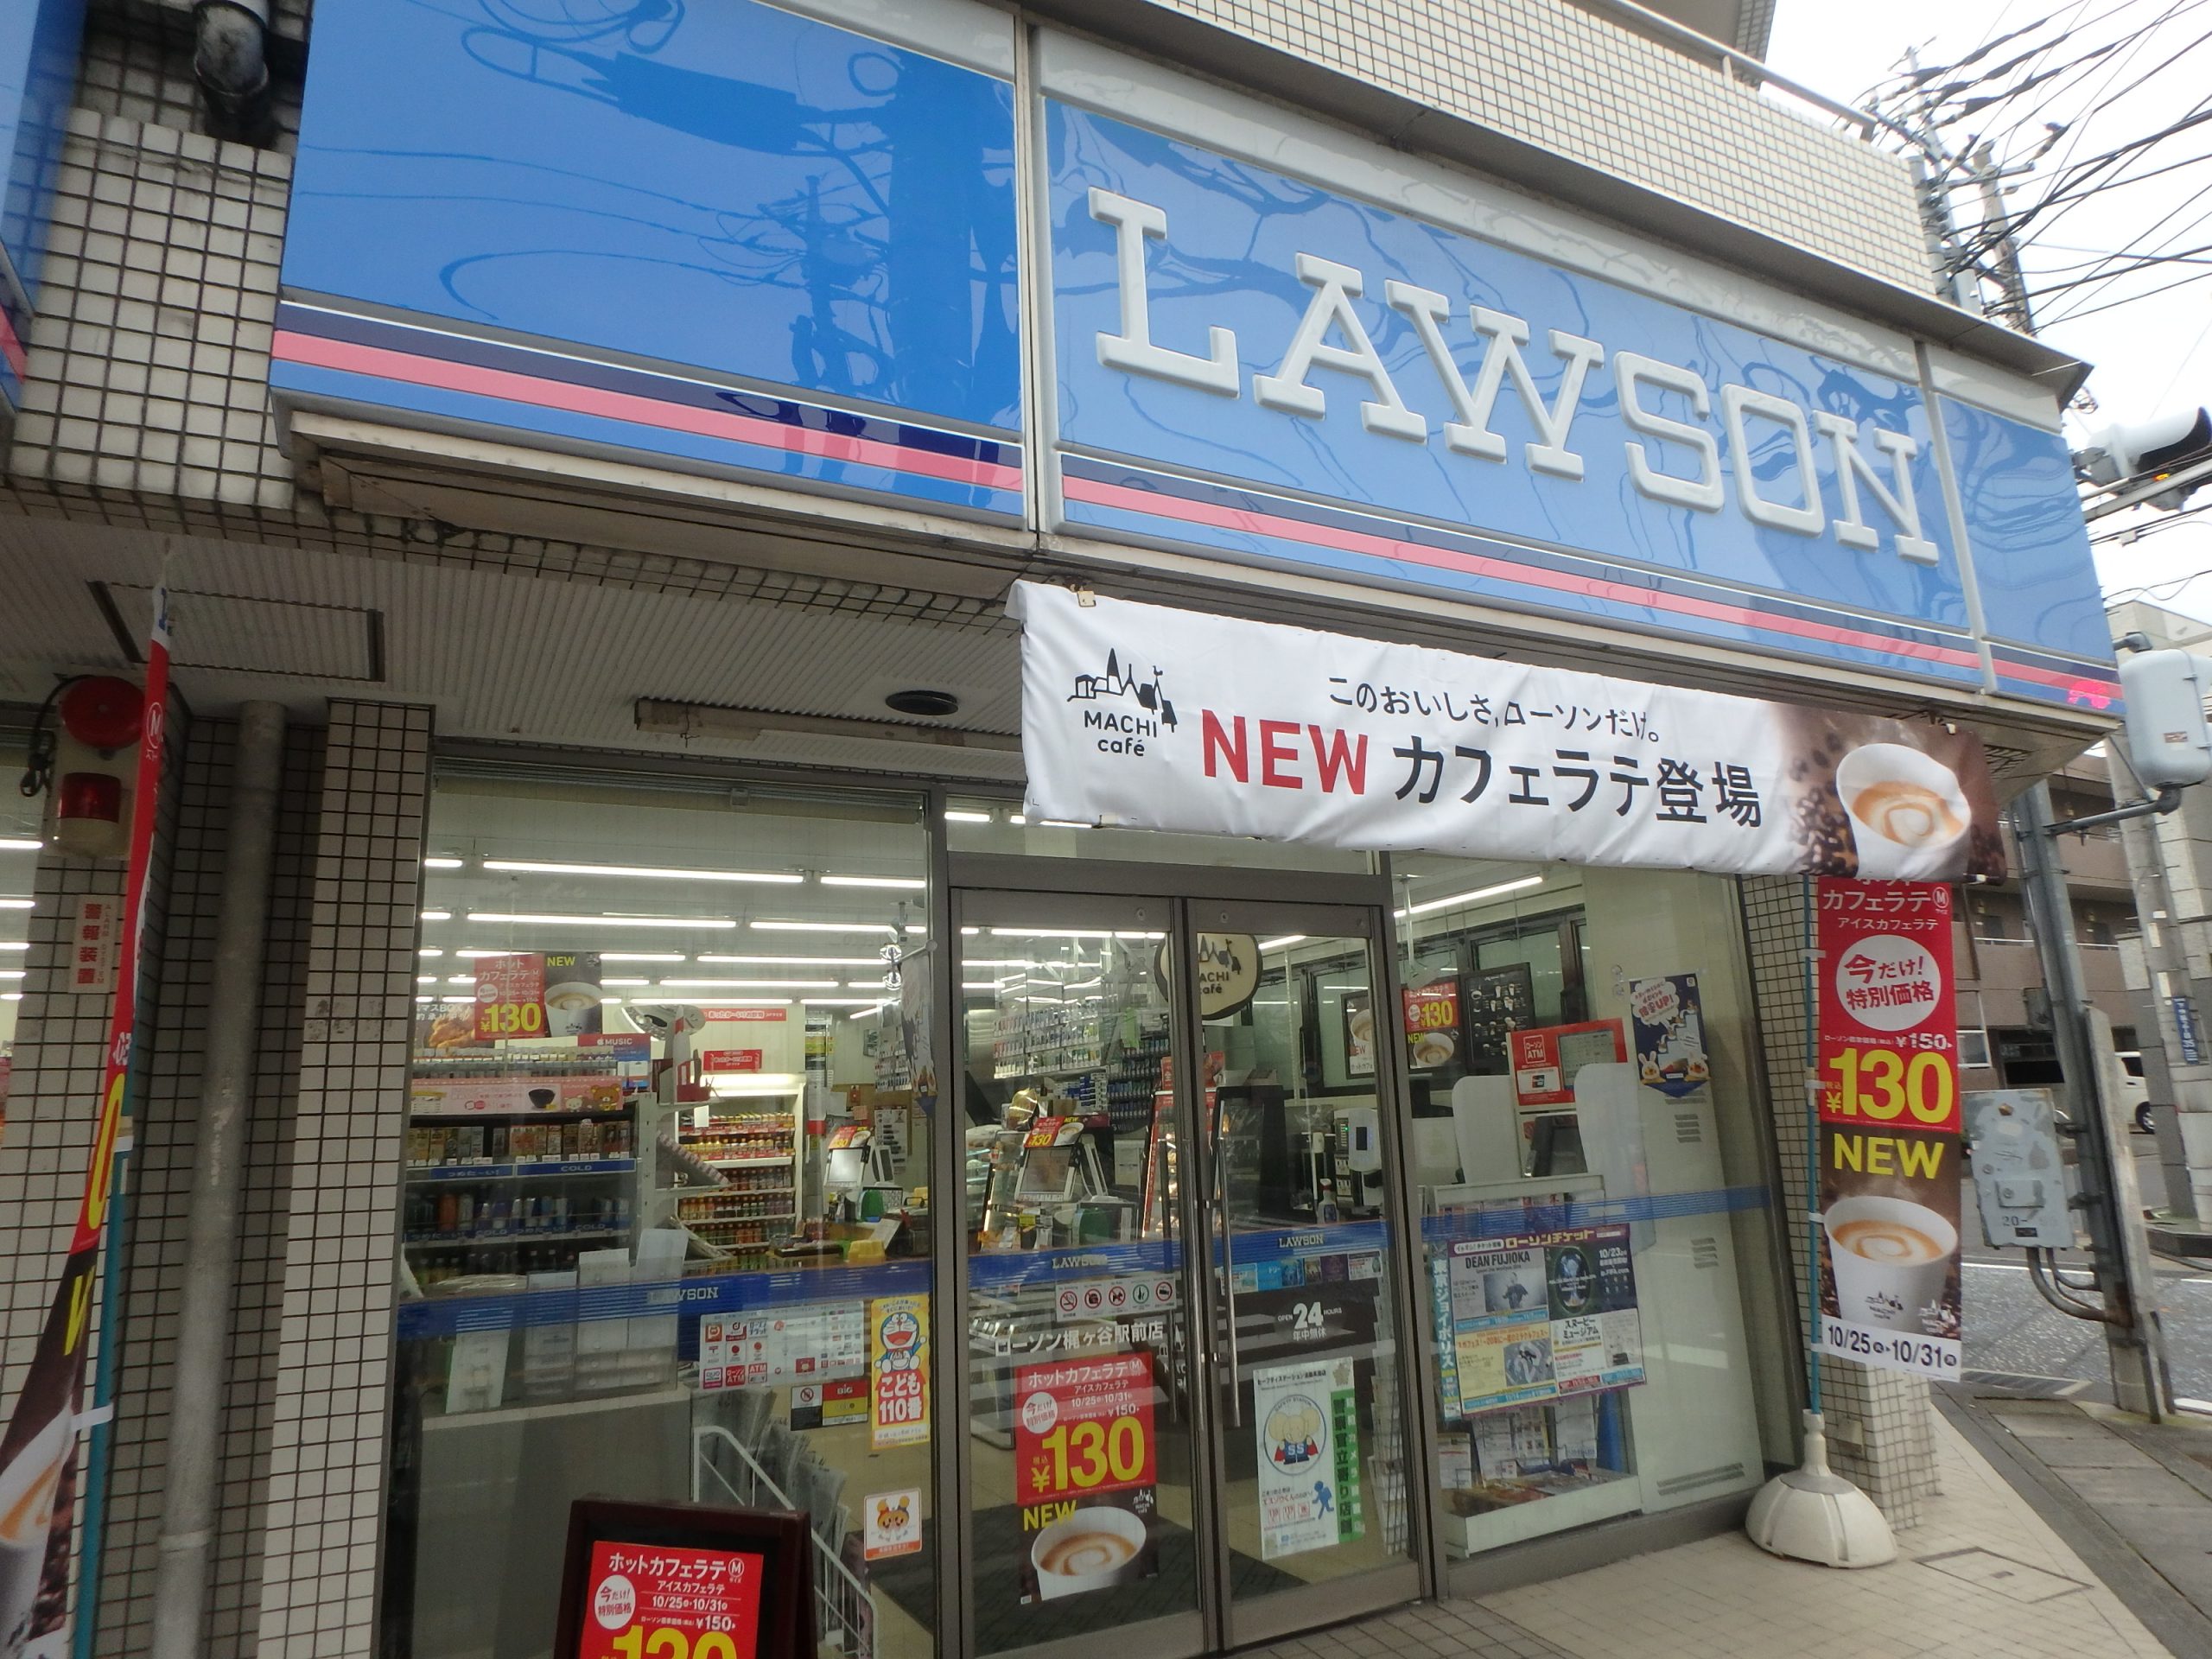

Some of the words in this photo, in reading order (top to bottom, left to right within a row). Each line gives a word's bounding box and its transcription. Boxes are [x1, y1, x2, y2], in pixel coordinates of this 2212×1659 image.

[1089, 187, 1937, 566] LAWSON
[1084, 709, 1158, 738] MACHI
[1097, 737, 1145, 757] café
[1202, 709, 1368, 796] NEW
[1393, 735, 1761, 828] カフェラテ登場
[1823, 889, 1931, 912] カフェラテ
[1838, 917, 1939, 931] アイスカフェラテ
[547, 957, 575, 967] NEW
[1844, 954, 1923, 983] 今だけ!
[480, 969, 530, 982] カフェラテ
[1200, 971, 1230, 982] ACHI
[1201, 983, 1223, 995] afé
[1846, 981, 1935, 1010] 特別価格
[1408, 1033, 1426, 1044] NEW
[1528, 1050, 1543, 1059] ATM
[1834, 1133, 1945, 1179] NEW
[1279, 1234, 1324, 1248] LAWSON
[1505, 1229, 1595, 1249] ローソンチケット
[1052, 1255, 1108, 1268] LAWSON
[1465, 1255, 1492, 1269] DEAN
[1492, 1250, 1530, 1266] FUJIOKA
[1293, 1301, 1324, 1329] 24
[1324, 1307, 1342, 1316] HOURS
[1293, 1326, 1327, 1341] 年中無休
[1028, 1361, 1128, 1388] ホットカフェラテ
[880, 1372, 921, 1398] こども
[1074, 1380, 1129, 1395] アイスカフェラテ
[880, 1395, 922, 1424] 110番
[1023, 1499, 1077, 1532] NEW
[608, 1552, 727, 1580] ホットカフェラテ
[657, 1580, 725, 1596] アイスカフェラテ
[696, 1615, 732, 1631] ¥150
